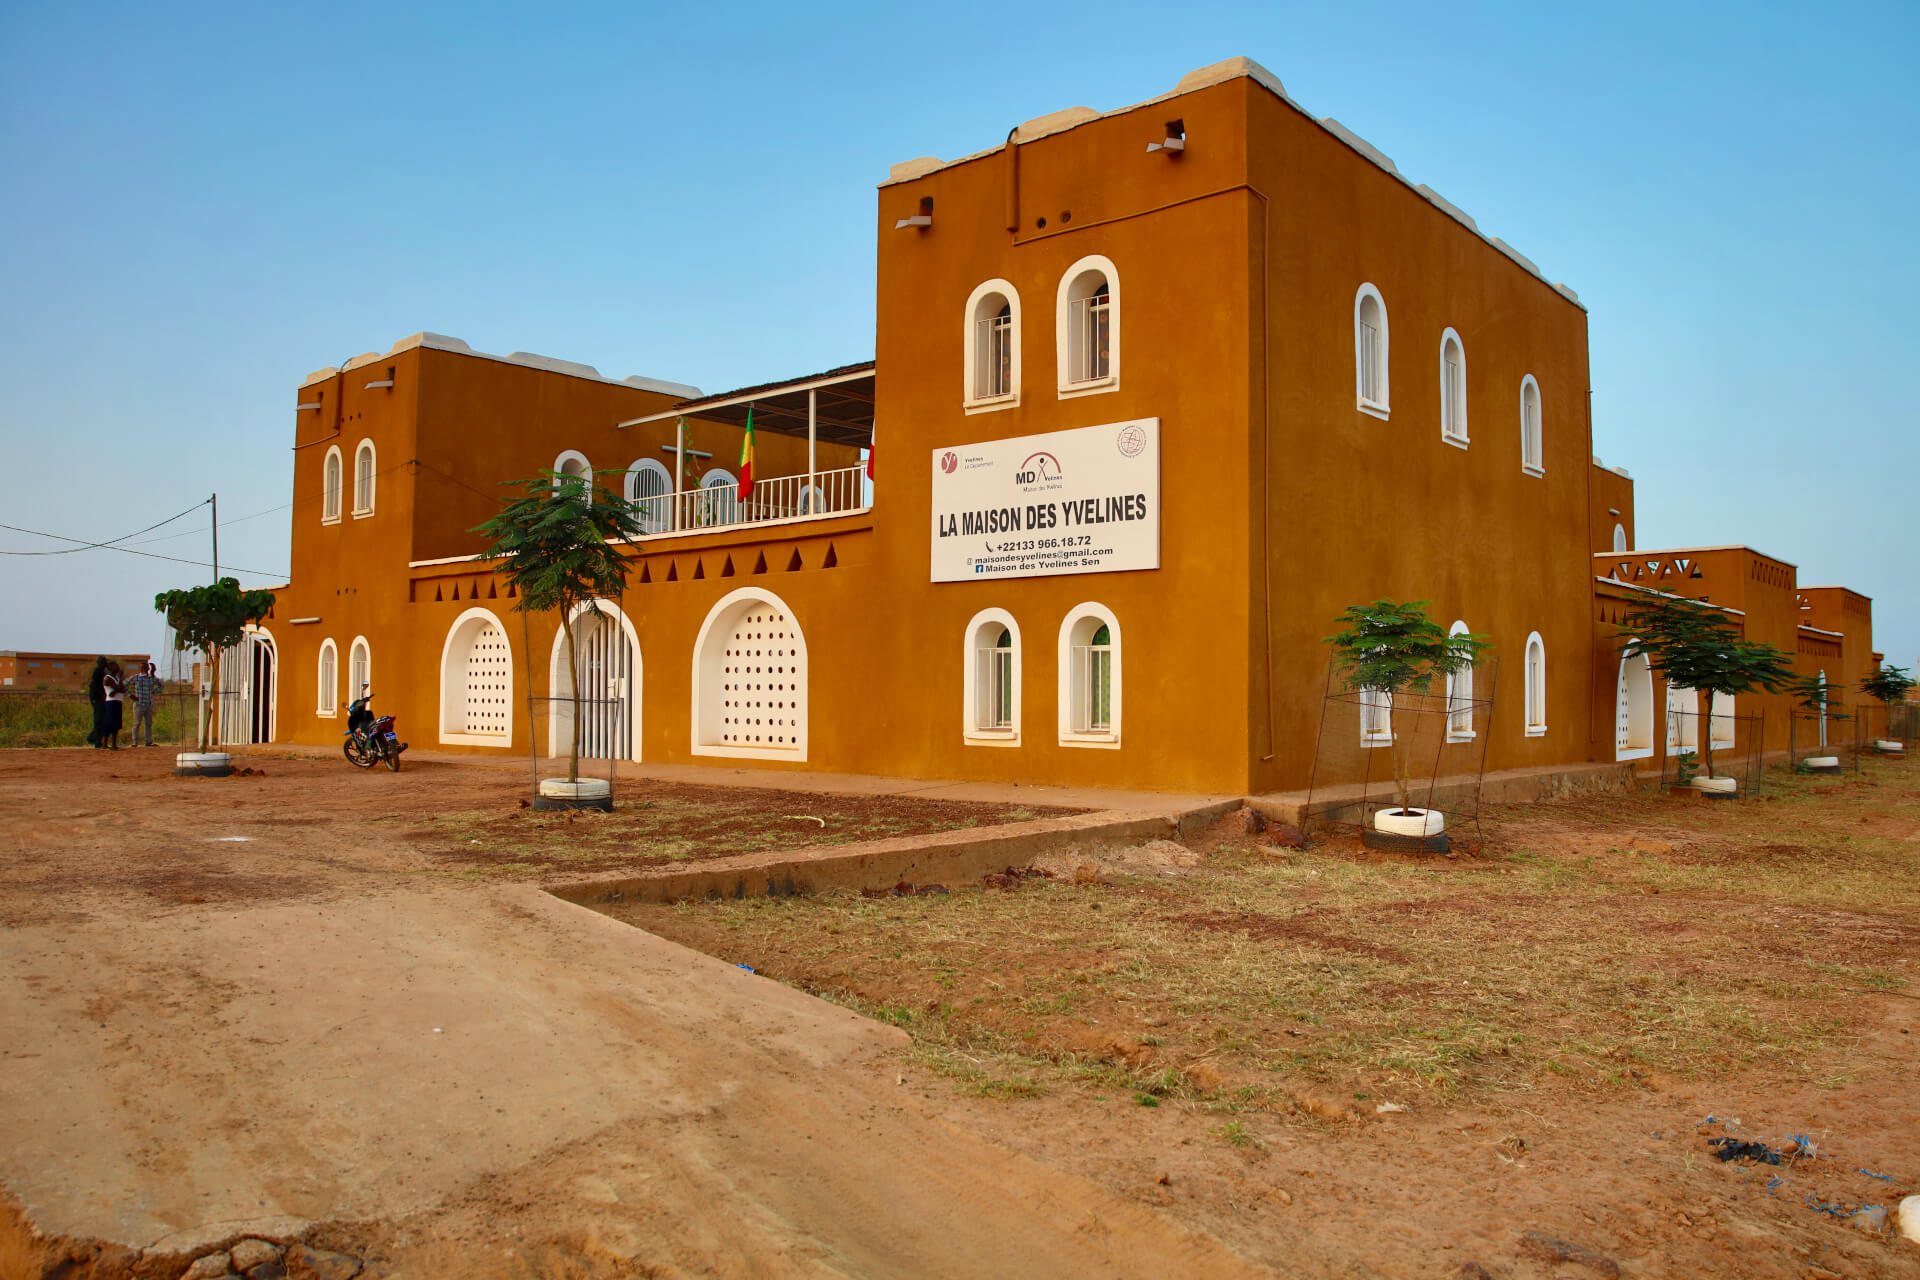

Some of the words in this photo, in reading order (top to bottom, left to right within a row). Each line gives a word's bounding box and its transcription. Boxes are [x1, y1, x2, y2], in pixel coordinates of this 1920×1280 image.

[1016, 471, 1036, 485] MD
[940, 514, 957, 537] LA
[962, 506, 1021, 536] MAISON
[1026, 503, 1057, 530] DES
[1062, 493, 1147, 527] YVELINES
[996, 540, 1035, 552] +22133
[1038, 535, 1091, 549] 966.18.72
[985, 564, 1017, 573] Maison
[1019, 562, 1036, 571] des
[1038, 560, 1079, 569] Yvelines
[1081, 558, 1100, 566] Sen
